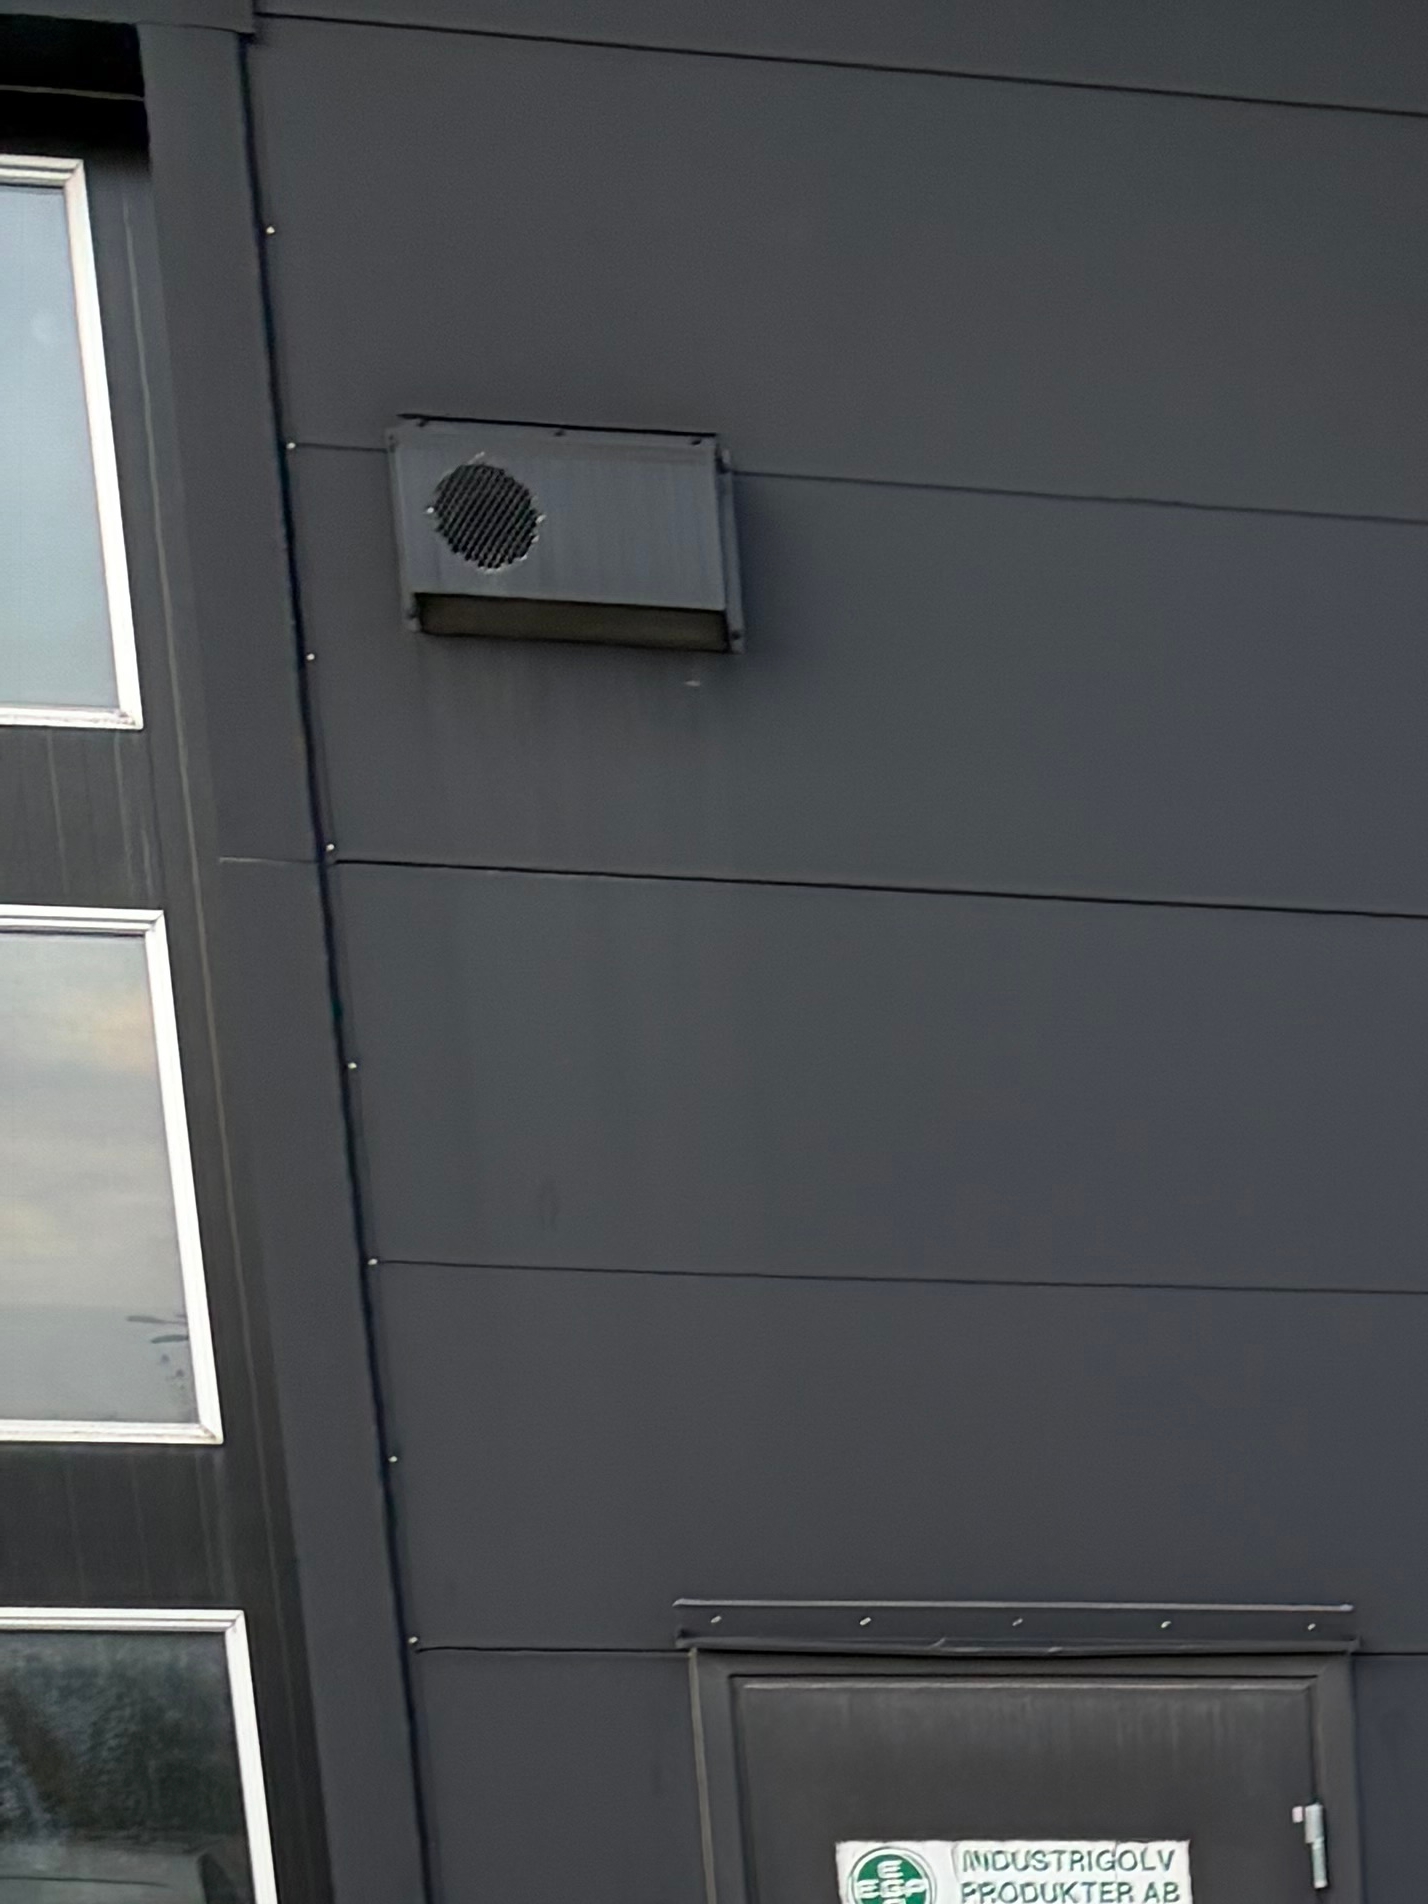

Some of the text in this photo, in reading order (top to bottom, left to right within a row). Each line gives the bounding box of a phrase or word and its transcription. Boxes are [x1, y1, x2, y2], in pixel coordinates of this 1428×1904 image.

[962, 1849, 1175, 1872] INDUSTRIGOLV
[960, 1881, 1180, 1904] PRODUKTER AB
